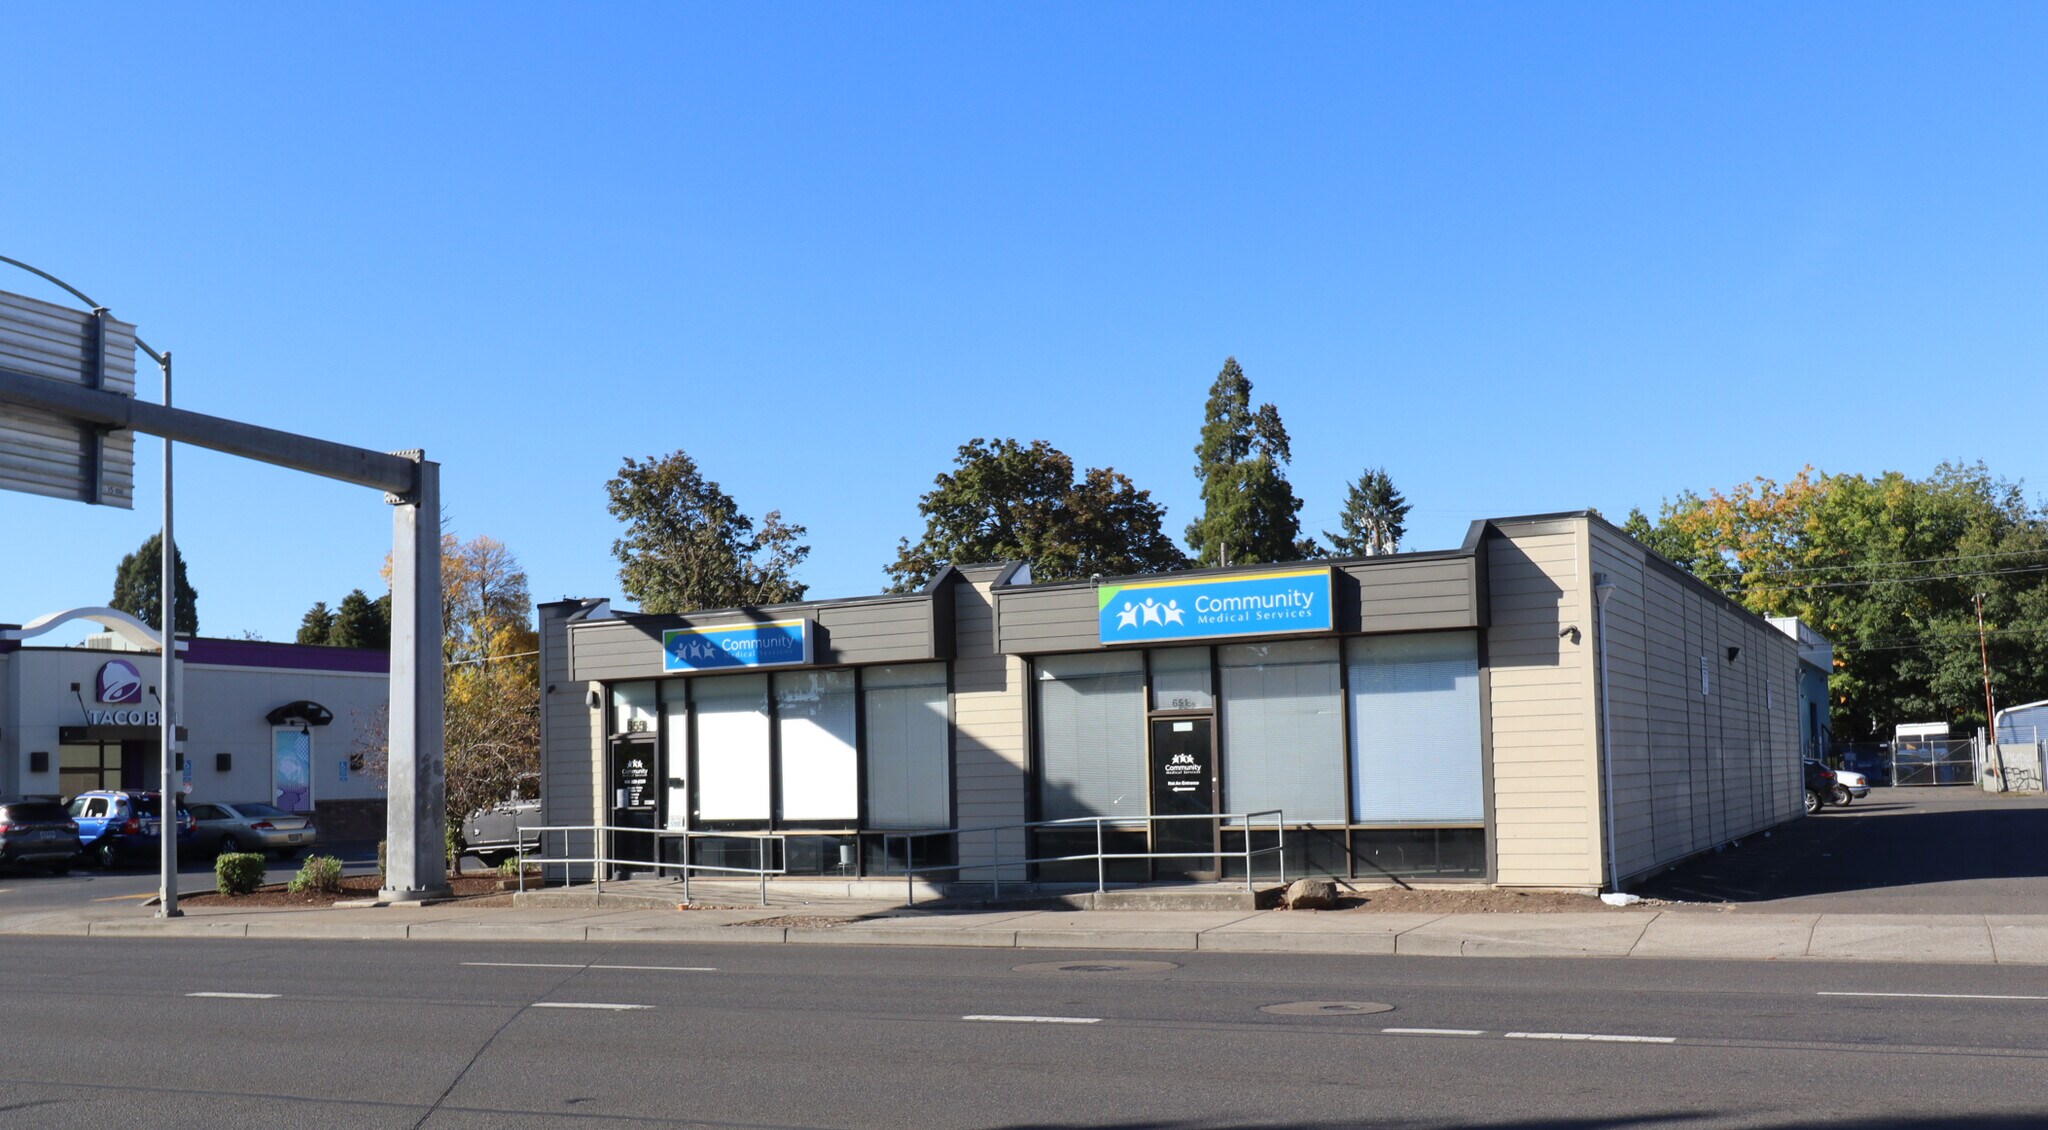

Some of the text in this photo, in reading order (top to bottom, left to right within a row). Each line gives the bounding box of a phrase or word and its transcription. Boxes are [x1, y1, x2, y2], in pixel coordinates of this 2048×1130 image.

[1195, 589, 1314, 613] Community
[1198, 609, 1313, 624] Medical Services
[722, 635, 794, 651] Community
[724, 650, 756, 658] Medical
[89, 710, 142, 725] TACO
[1165, 764, 1201, 772] Community
